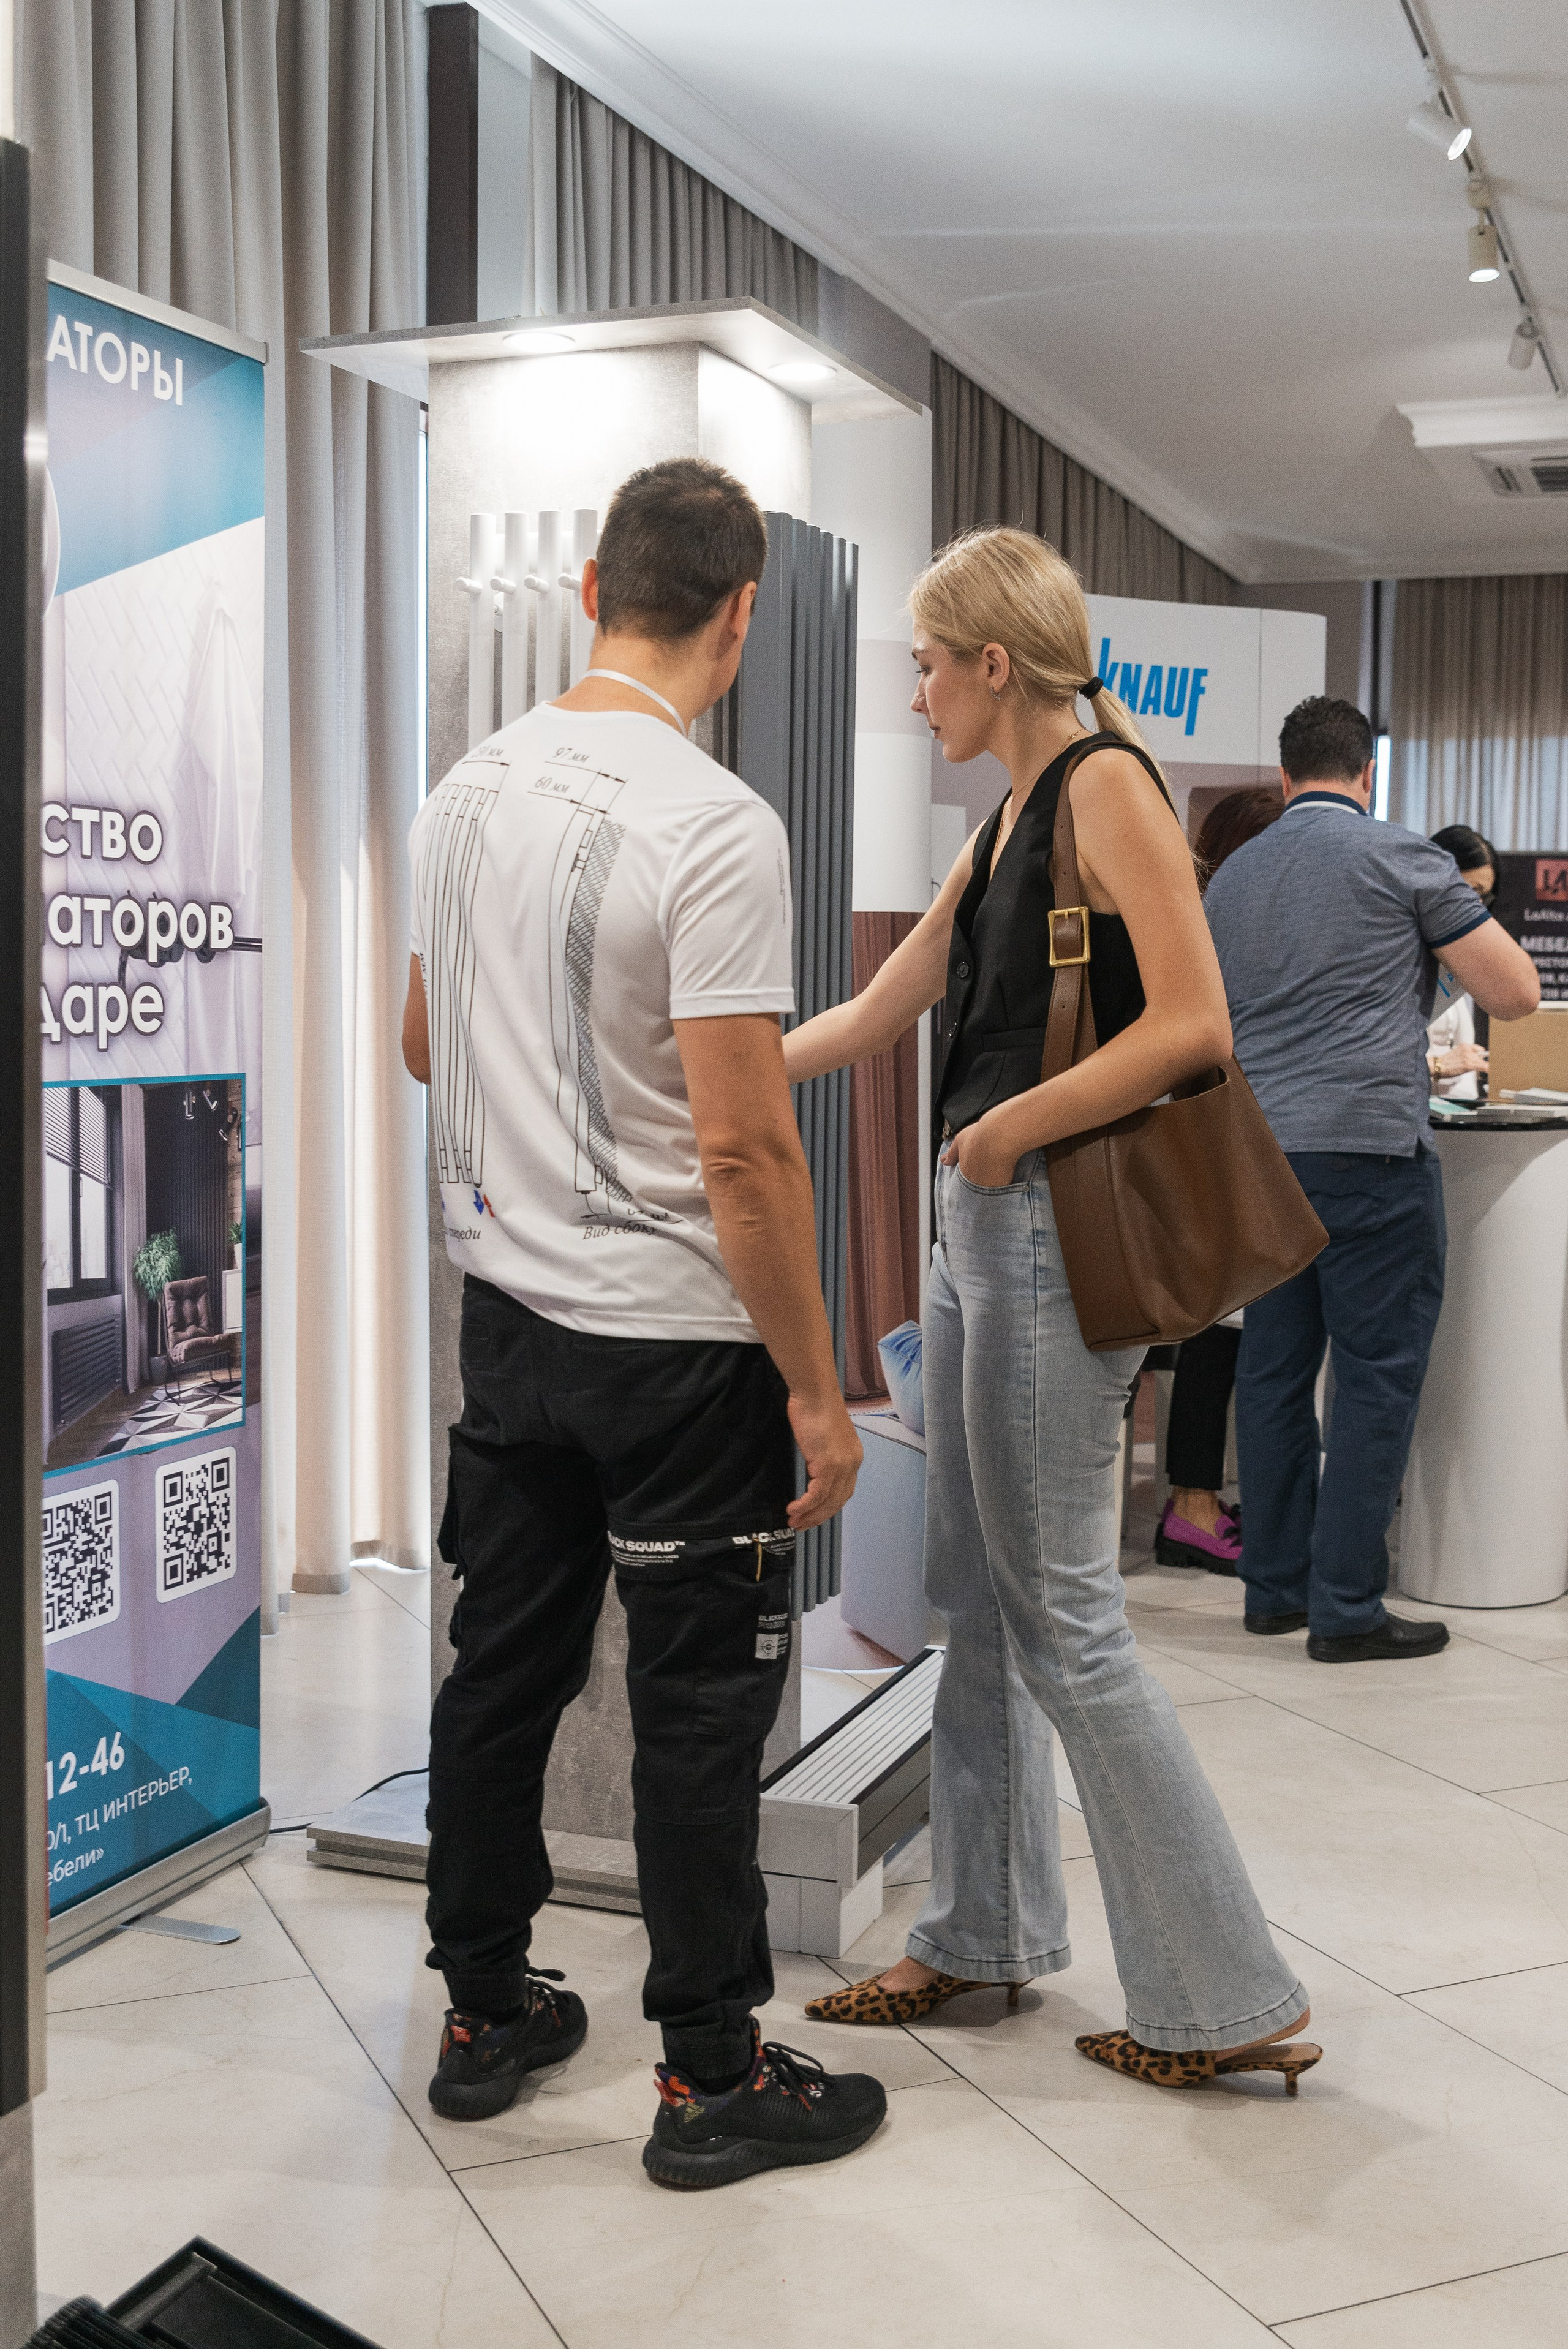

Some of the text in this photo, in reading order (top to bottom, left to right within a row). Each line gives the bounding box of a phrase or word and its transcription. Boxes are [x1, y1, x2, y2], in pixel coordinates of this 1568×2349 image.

[47, 315, 183, 405] АТОРЫ
[1097, 638, 1208, 736] KNAUF
[535, 777, 553, 790] 60
[552, 747, 572, 758] 97
[48, 894, 235, 963] аторов
[582, 1223, 610, 1240] Вид
[74, 1809, 100, 1835] ТЦ
[104, 1766, 192, 1823] ИНТЕРЬЕР,
